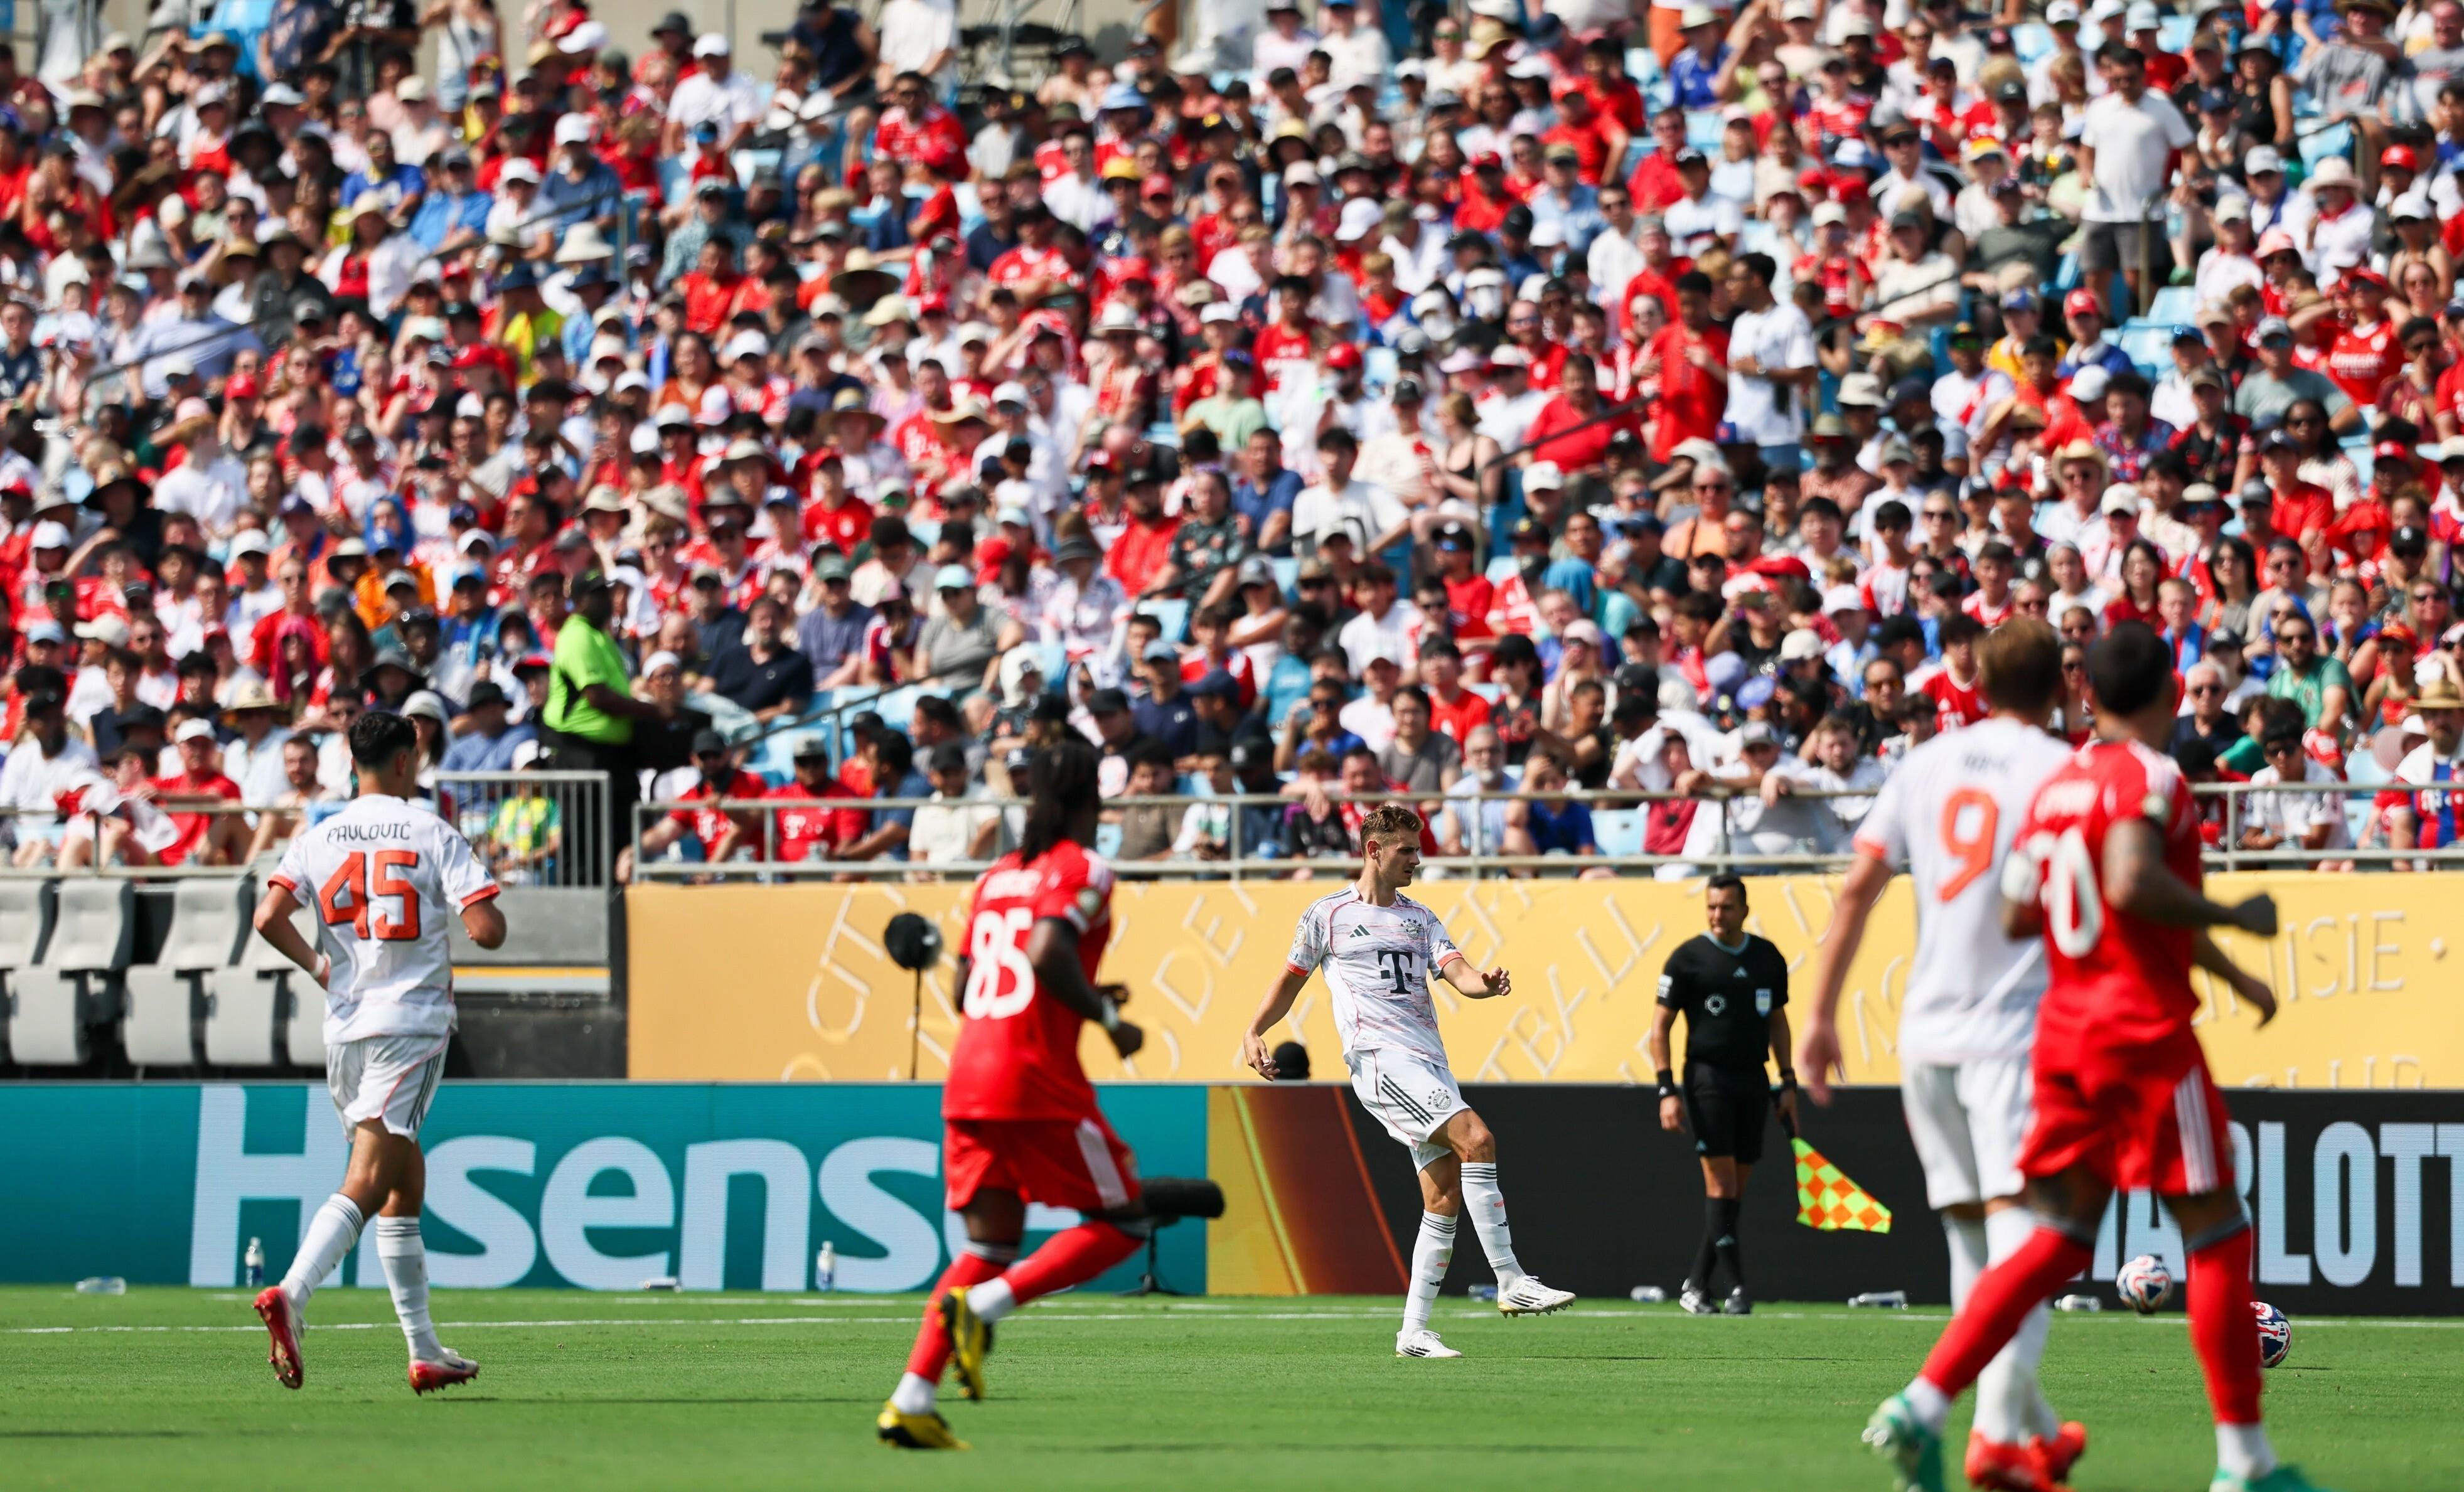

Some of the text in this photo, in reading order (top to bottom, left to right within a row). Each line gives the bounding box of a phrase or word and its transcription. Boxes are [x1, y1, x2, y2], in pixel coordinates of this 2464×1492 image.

[326, 821, 412, 844] PAVLOVIĆ
[1935, 787, 2000, 905] 9
[319, 850, 421, 940] 45
[963, 906, 1036, 1020] 85
